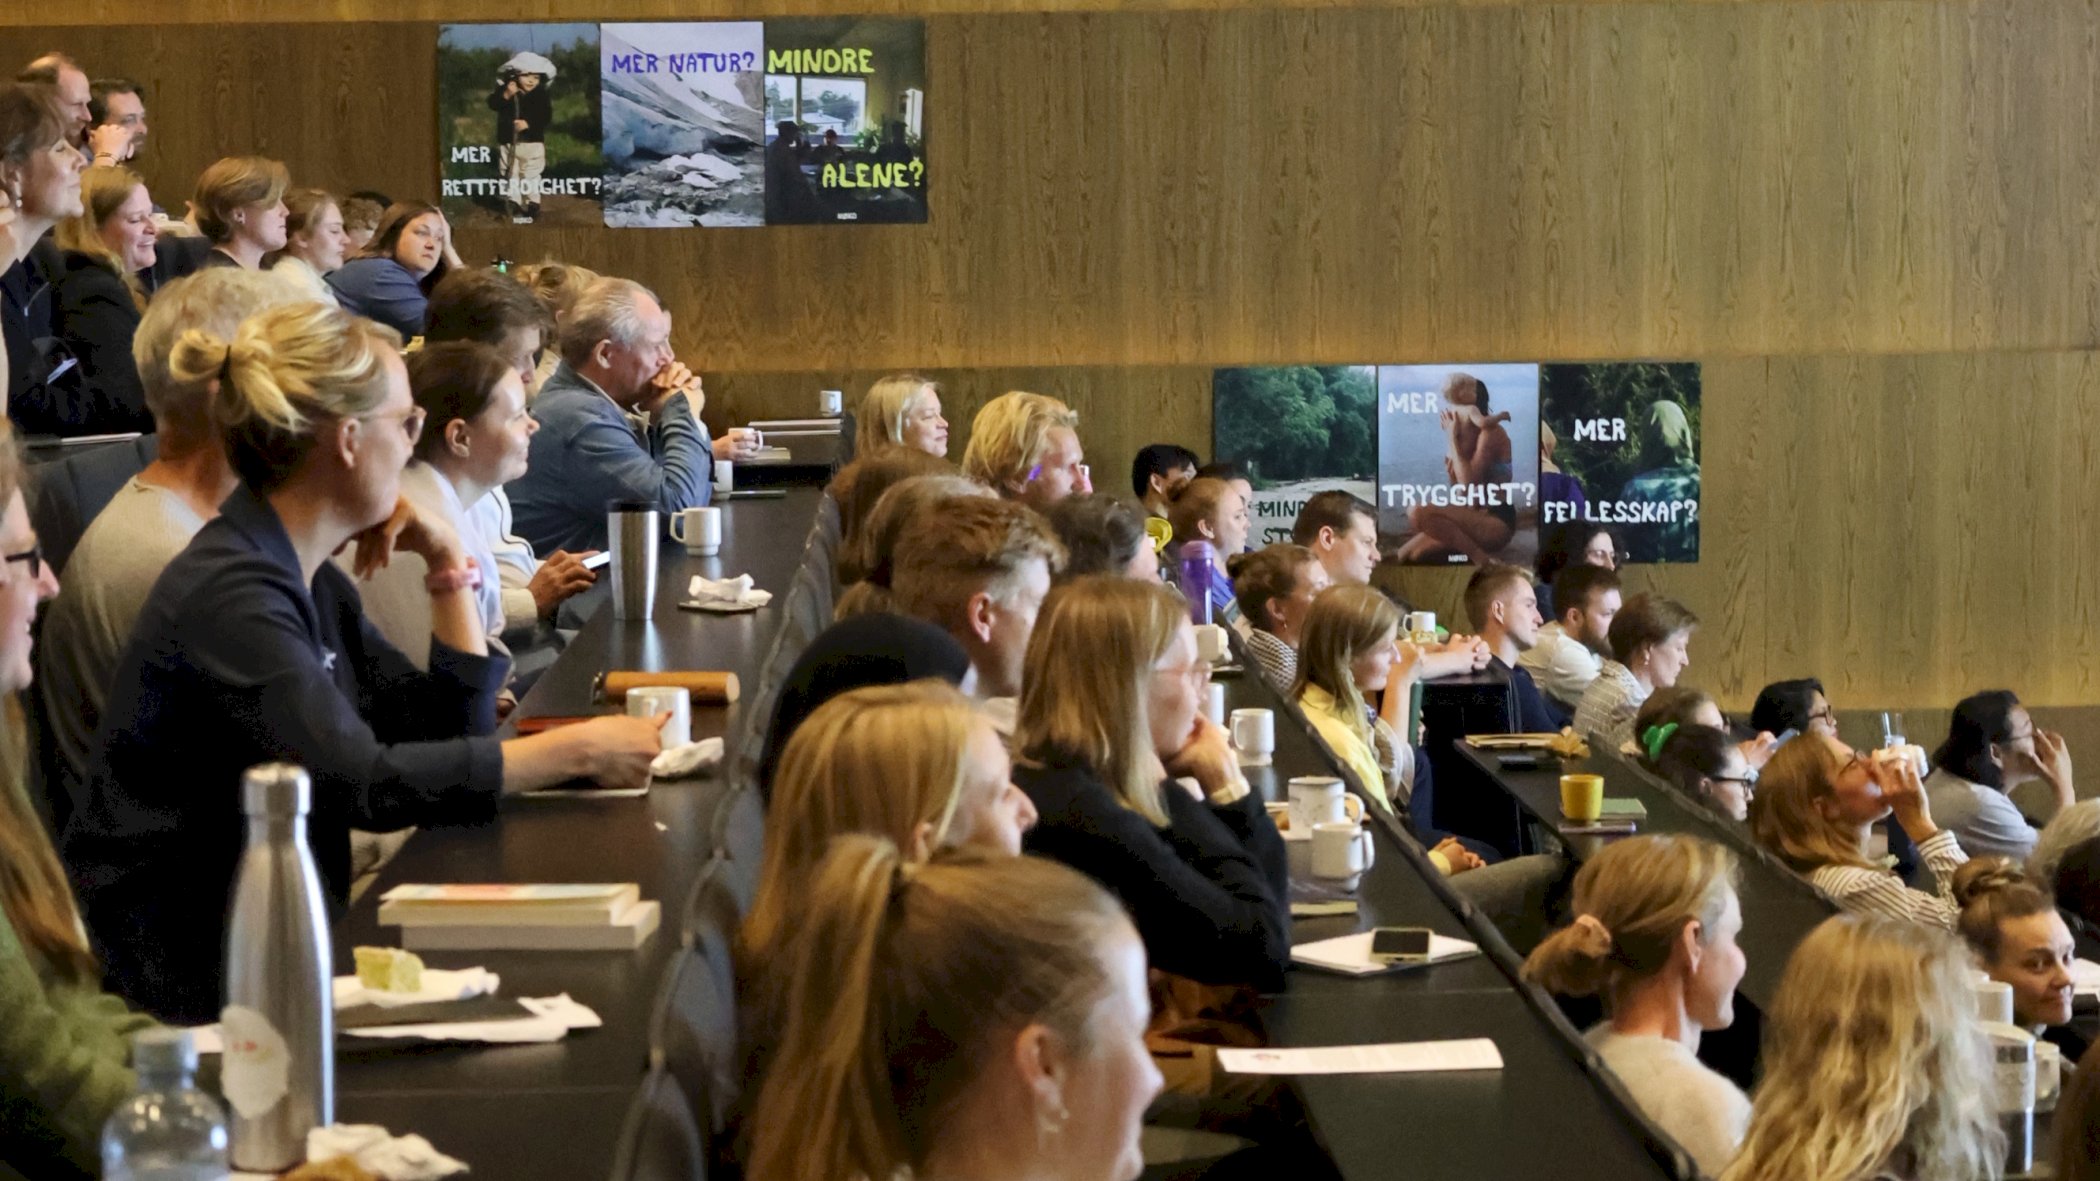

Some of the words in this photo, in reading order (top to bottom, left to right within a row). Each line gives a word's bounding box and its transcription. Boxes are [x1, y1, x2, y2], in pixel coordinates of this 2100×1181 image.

[611, 52, 658, 73] MER
[669, 51, 755, 73] NATUR?
[767, 48, 875, 73] MINDRE
[451, 146, 491, 163] MER
[822, 156, 924, 188] ALENE?
[442, 177, 602, 196] RETTFERDIGHET?
[1386, 392, 1439, 414] MER
[1573, 418, 1626, 441] MER
[1381, 481, 1536, 507] TRYGGHET?
